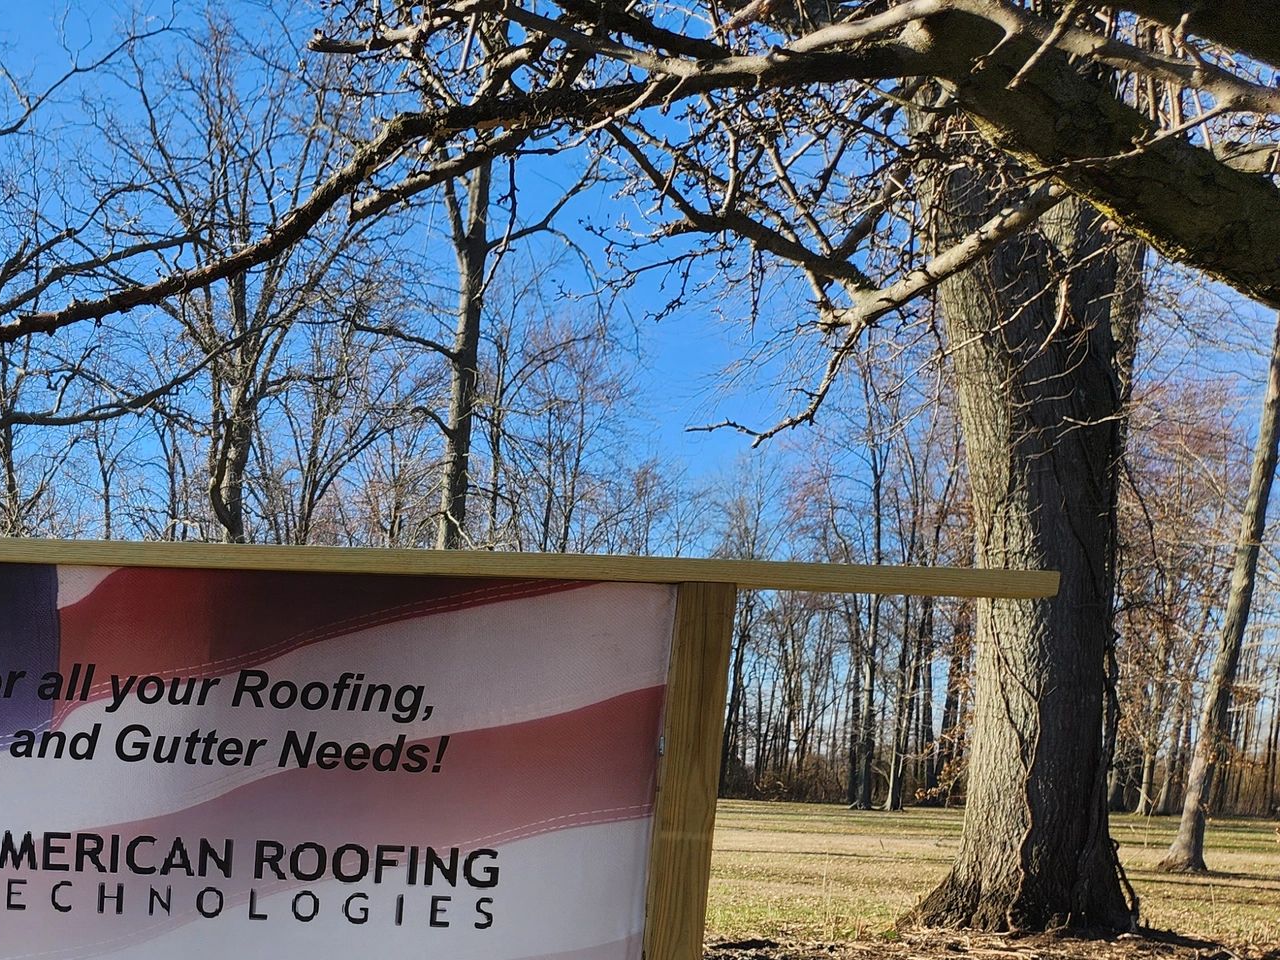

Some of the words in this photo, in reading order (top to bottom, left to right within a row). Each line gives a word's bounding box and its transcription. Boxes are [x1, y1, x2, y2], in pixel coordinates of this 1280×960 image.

[38, 663, 95, 703] all
[104, 671, 218, 713] your
[232, 668, 436, 724] Roofing,
[8, 722, 102, 762] and
[114, 723, 266, 768] Gutter
[277, 730, 451, 774] Needs!
[253, 840, 500, 889] ROOFING
